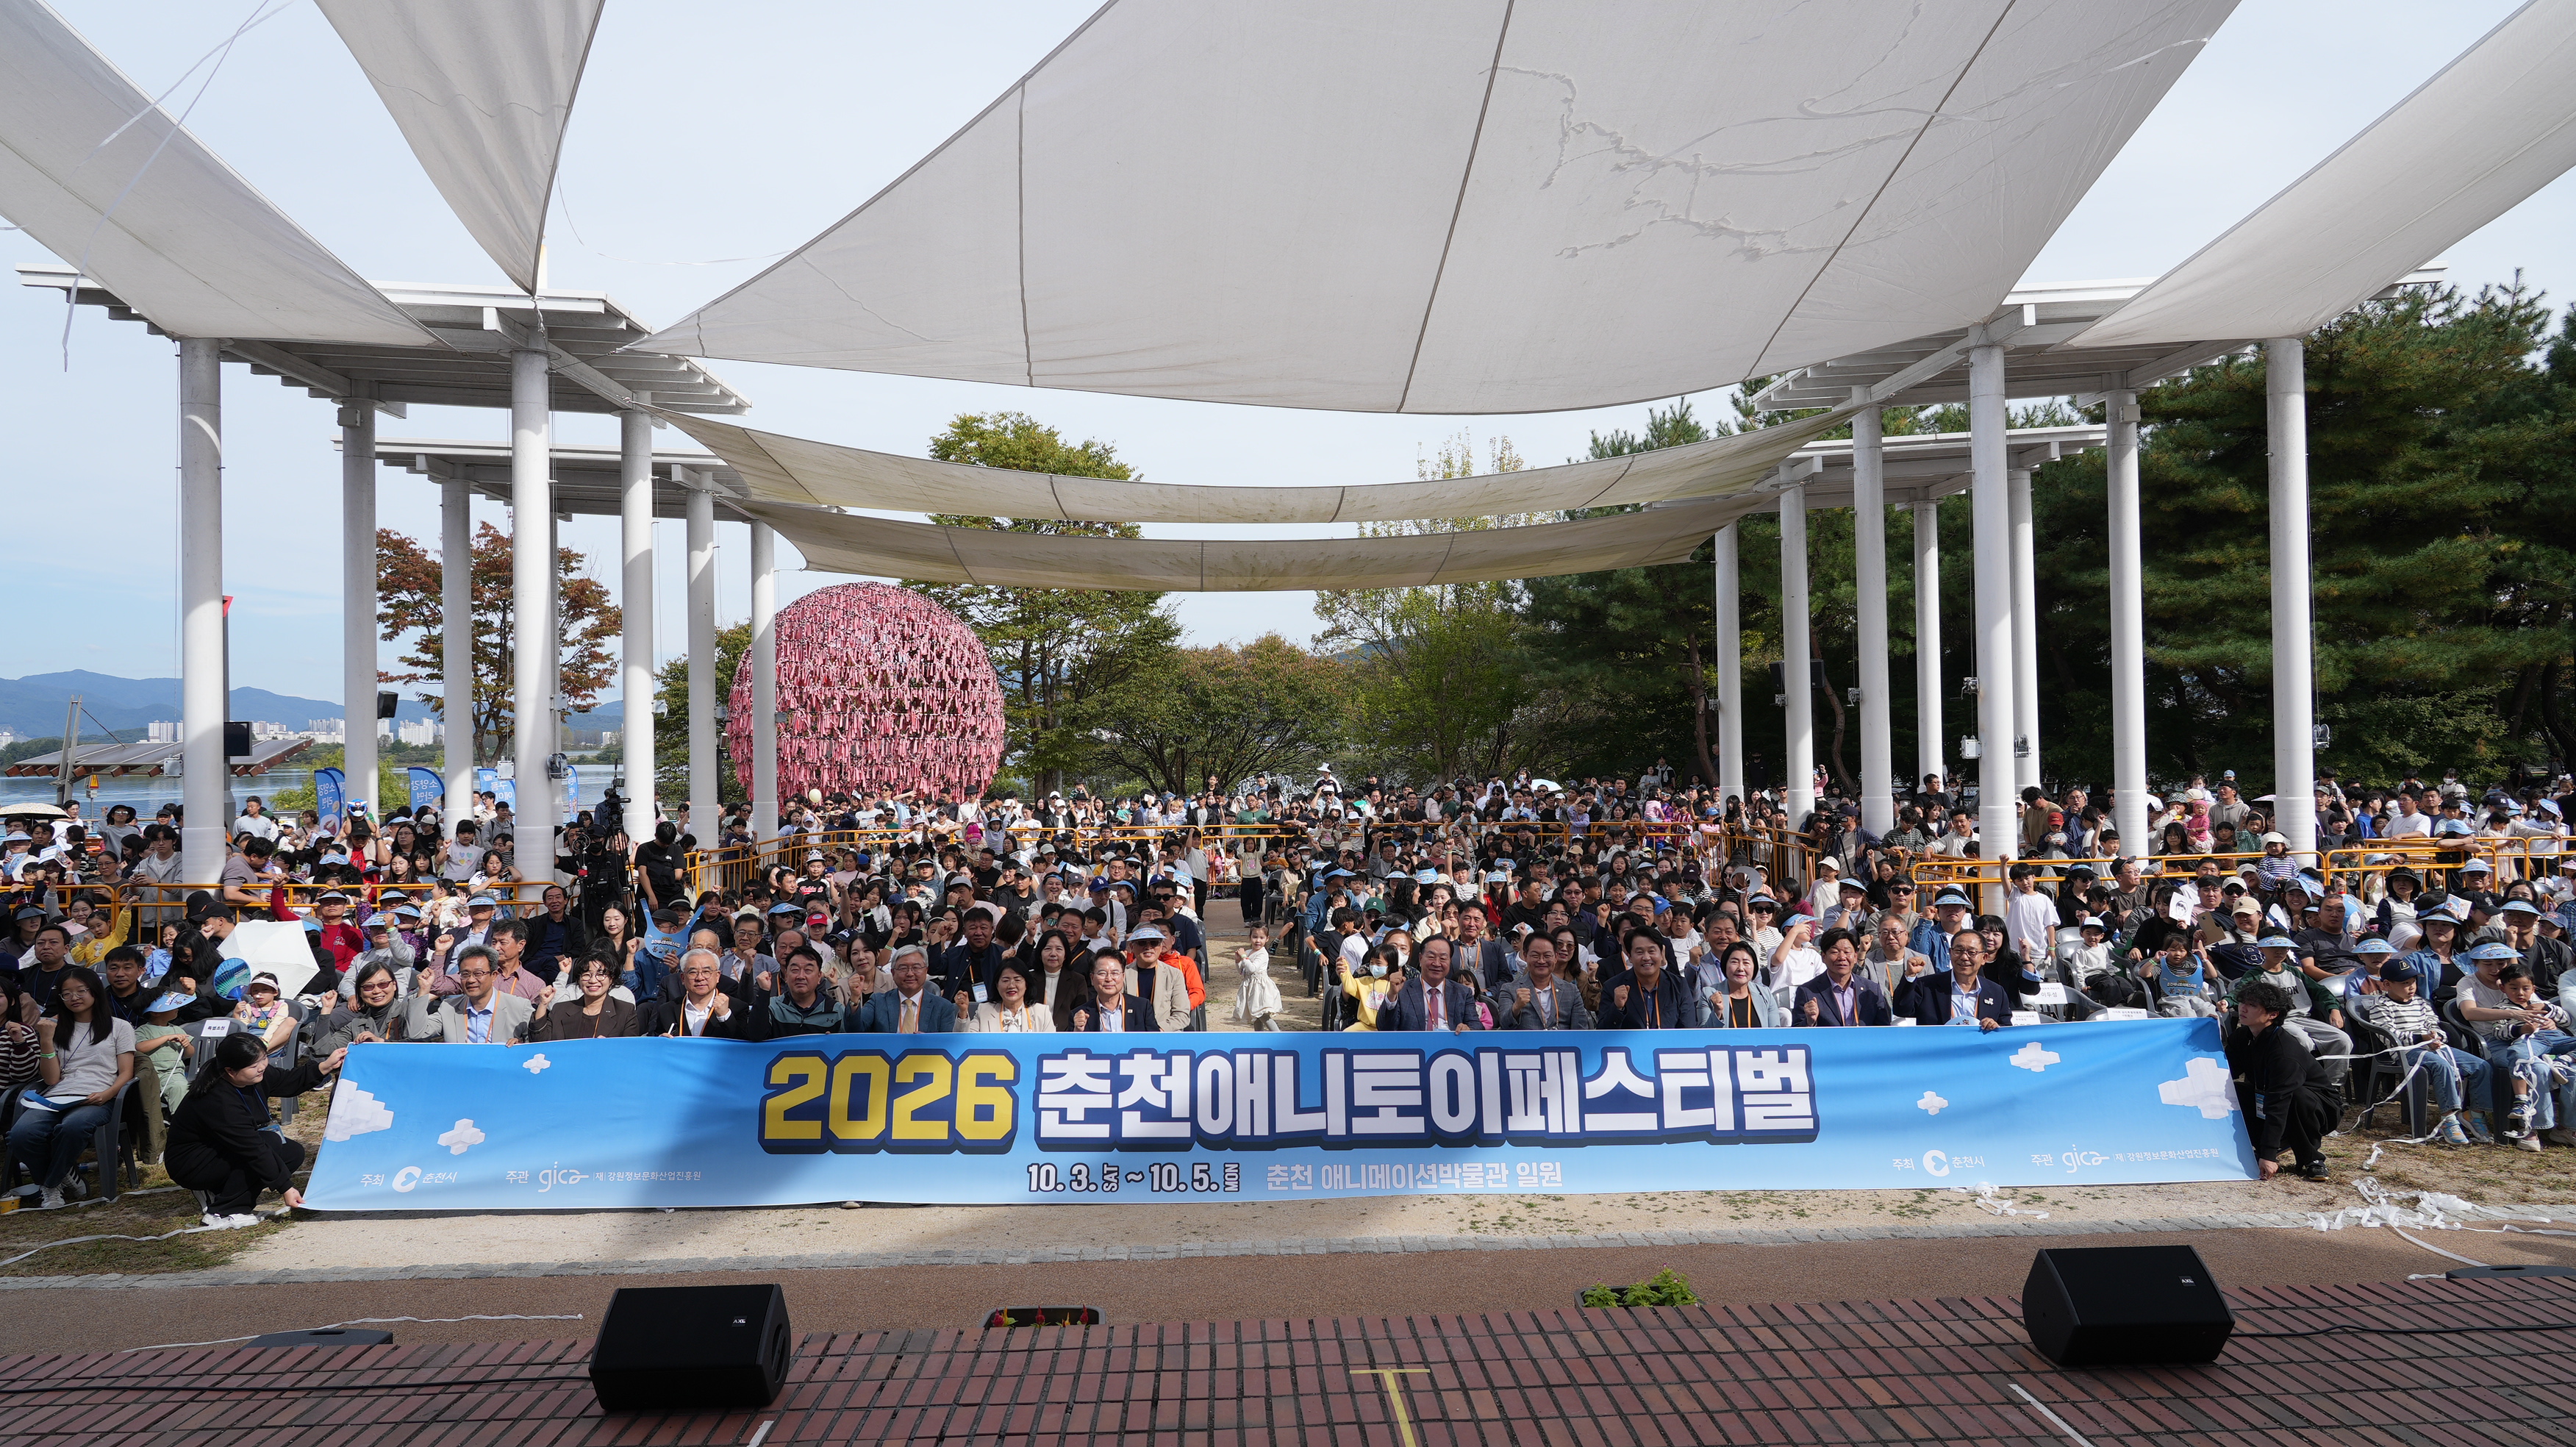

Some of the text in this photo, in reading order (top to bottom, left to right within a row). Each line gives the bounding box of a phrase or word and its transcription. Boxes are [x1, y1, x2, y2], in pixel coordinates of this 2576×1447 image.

[762, 1054, 1015, 1142] 2026
[1892, 1155, 1986, 1171] 주최 춘천시
[2031, 1153, 2054, 1167] 주관
[359, 1171, 458, 1187] 주최 춘천시
[505, 1170, 529, 1185] 주관
[1103, 1164, 1119, 1192] SAT
[1224, 1163, 1239, 1192] MON
[1267, 1162, 1563, 1191] 춘천 애니메이션박물관 일원
